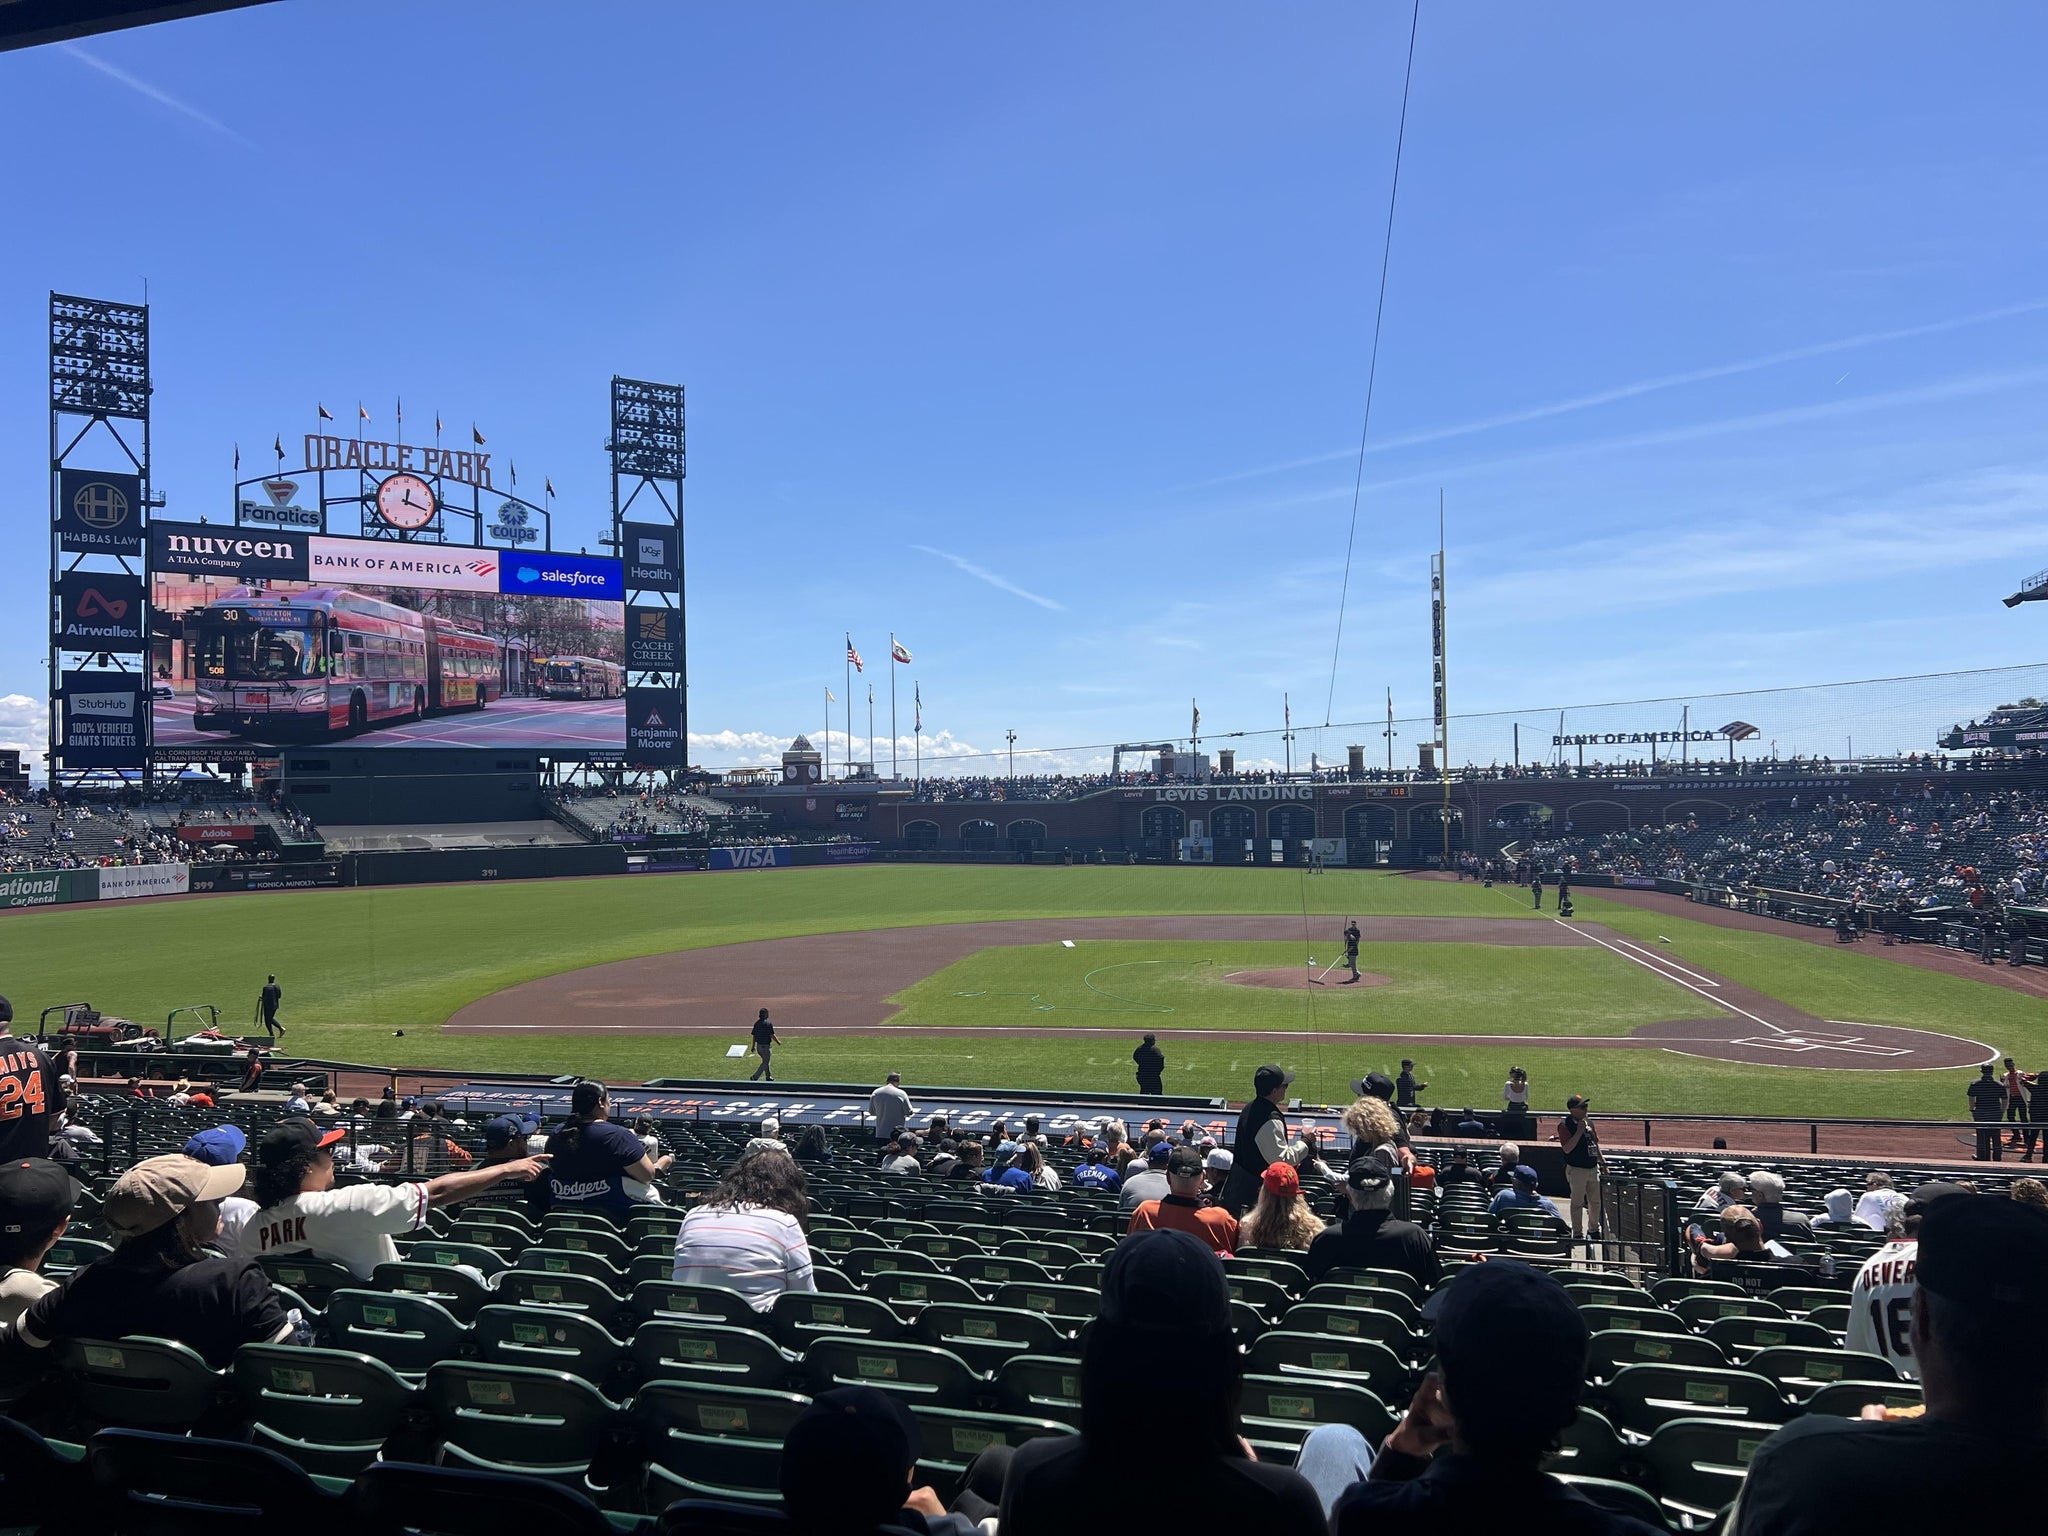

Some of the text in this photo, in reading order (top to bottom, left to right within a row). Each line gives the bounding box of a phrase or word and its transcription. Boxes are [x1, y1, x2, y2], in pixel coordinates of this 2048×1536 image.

[304, 434, 493, 490] ORACLE PARK
[242, 503, 320, 525] Fanatics
[64, 532, 138, 546] HABBAS LAW
[493, 526, 536, 542] coupa
[168, 534, 294, 560] nuveen
[641, 546, 661, 558] UCSF
[176, 556, 200, 564] TIAA
[202, 558, 242, 568] Company
[314, 555, 462, 574] BANK OF AMERICA
[542, 570, 606, 586] salesforce
[631, 566, 672, 580] Health
[223, 610, 238, 620] 30
[66, 624, 138, 638] Airwallex
[632, 641, 674, 651] CACHE
[633, 651, 673, 660] CREEK
[78, 699, 127, 709] StubHub
[72, 722, 133, 734] 100% VERIFIED
[630, 727, 678, 739] Benjamin
[69, 736, 136, 747] GIANTS TICKETS
[638, 739, 672, 748] Moore
[1552, 730, 1714, 746] BANK OF AMERICA
[1216, 787, 1313, 800] LANDING
[726, 849, 776, 867] VISA
[137, 878, 170, 886] AMERICA
[194, 882, 214, 890] 399
[11, 894, 56, 905] Car Rental
[0, 1052, 38, 1076] MAYS
[0, 1070, 45, 1121] 24
[711, 1101, 816, 1118] SAN
[823, 1105, 1114, 1130] FNCISCO
[1077, 1170, 1107, 1181] FREEMAN
[551, 1179, 610, 1200] Dodgers
[260, 1216, 307, 1251] PARK
